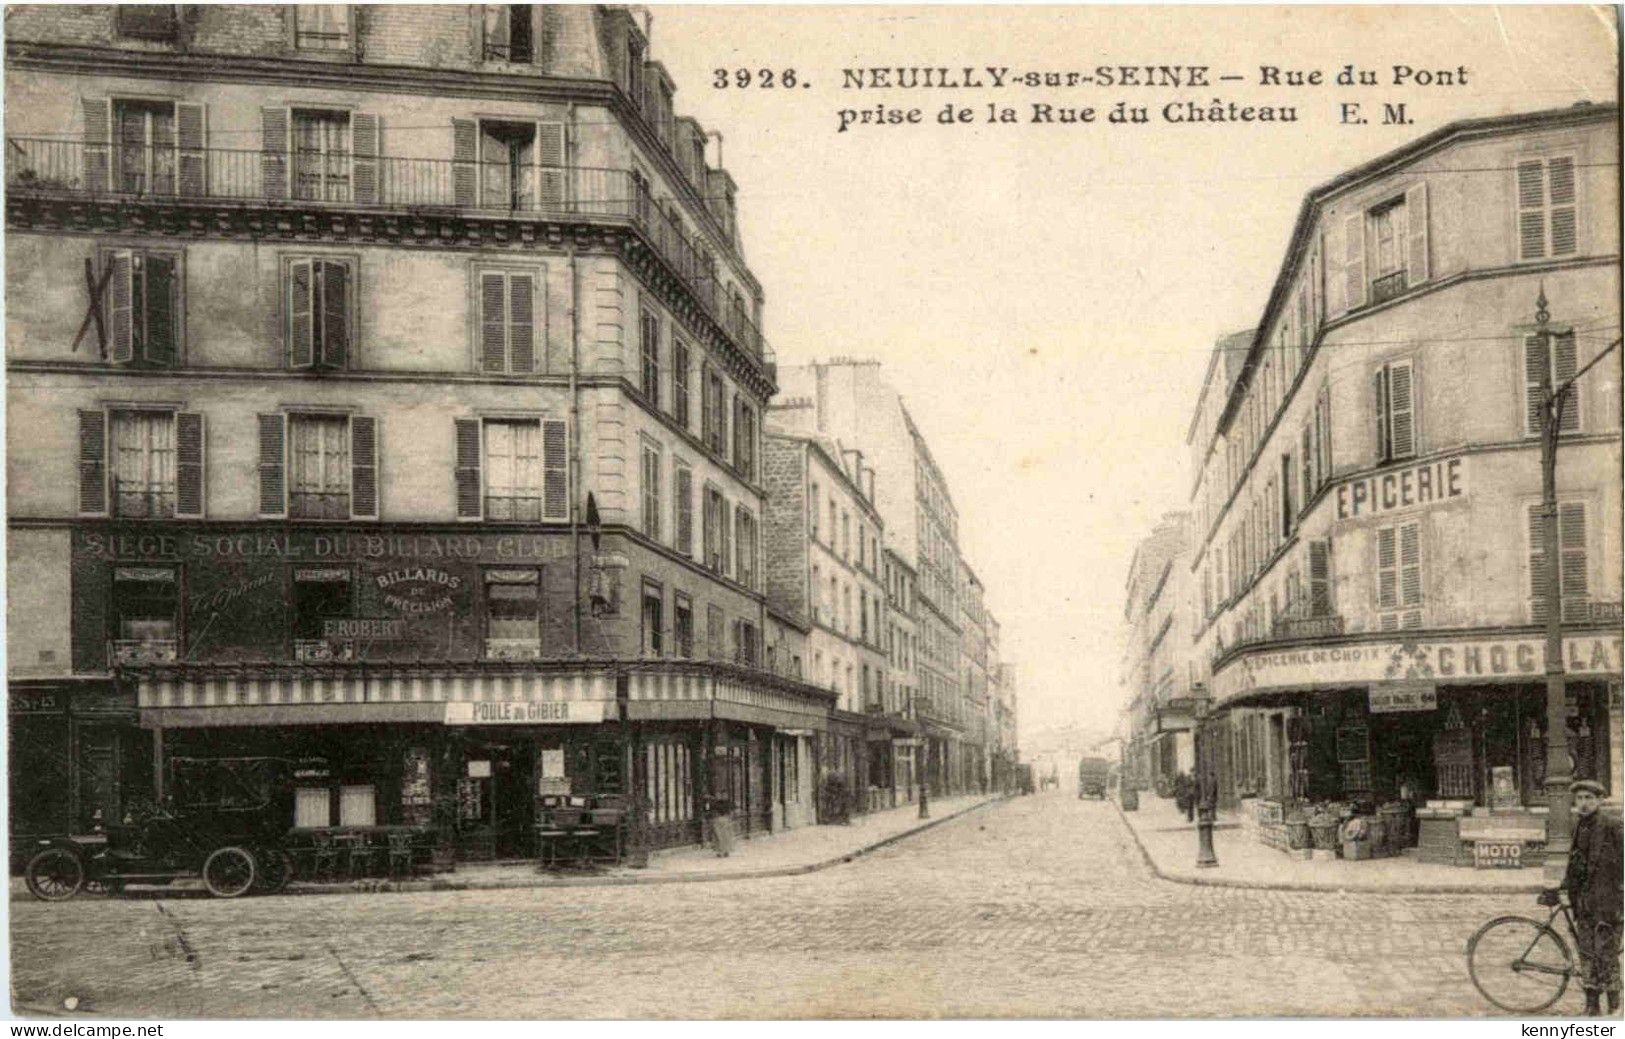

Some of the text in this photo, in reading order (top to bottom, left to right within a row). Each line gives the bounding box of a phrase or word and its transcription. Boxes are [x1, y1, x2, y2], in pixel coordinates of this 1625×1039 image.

[1337, 459, 1462, 519] EPICERIE
[193, 535, 300, 557] SOCIAL
[314, 536, 351, 556] DU
[377, 568, 461, 589] BILLARDS
[337, 620, 400, 637] ROBERT
[1330, 649, 1379, 663] CHOIX
[1439, 639, 1623, 676] CHOCLAT
[472, 701, 512, 721] POULE
[527, 701, 569, 720] GIBIER
[1480, 844, 1521, 858] MOTO
